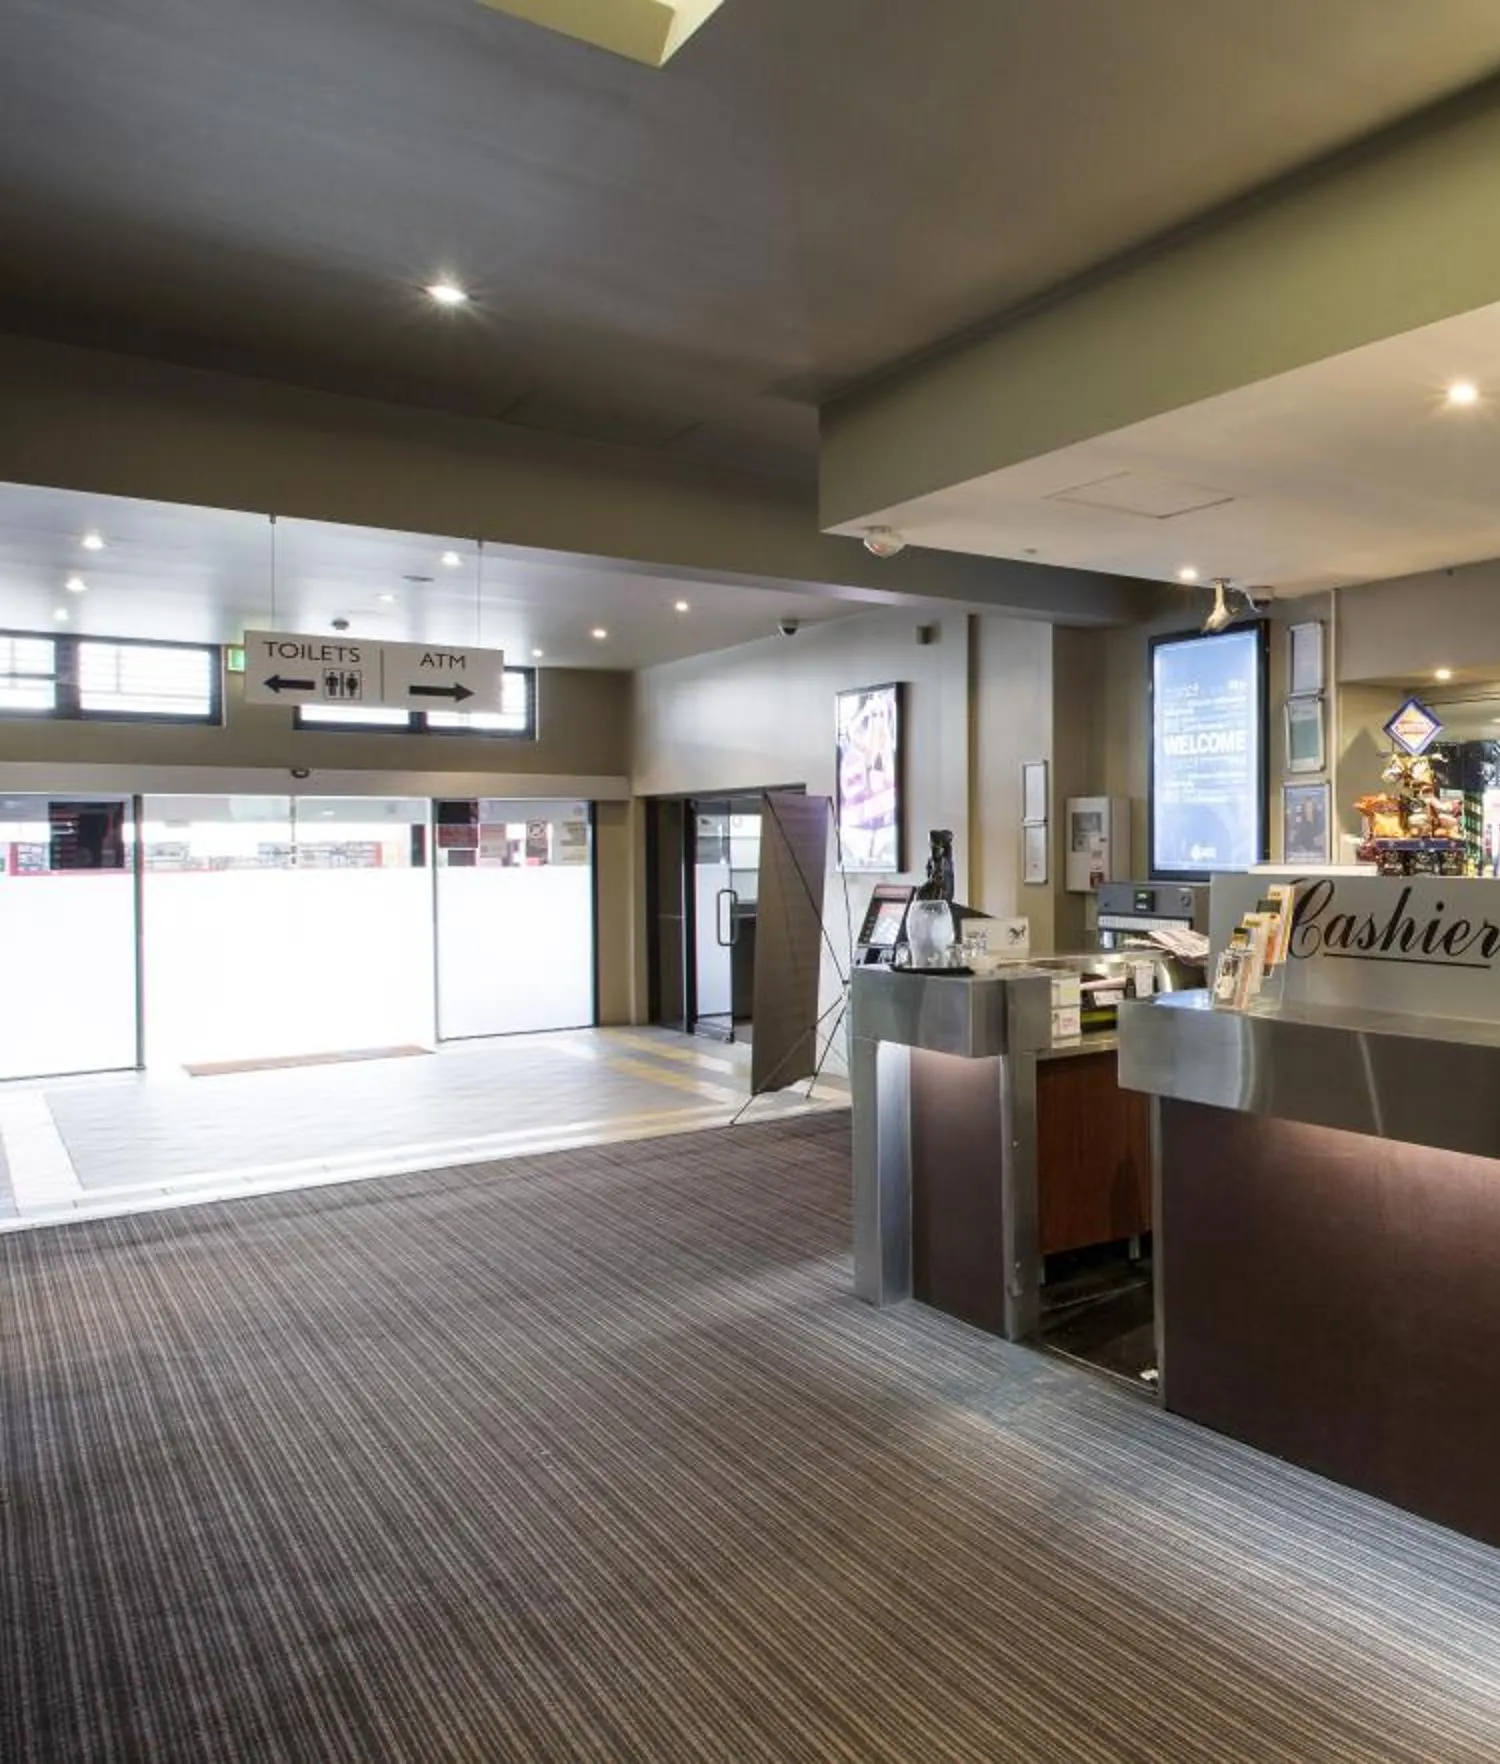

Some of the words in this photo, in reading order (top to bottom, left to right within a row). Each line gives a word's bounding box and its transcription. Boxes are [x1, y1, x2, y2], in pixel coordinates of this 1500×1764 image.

[263, 641, 360, 663] TOILETS
[420, 653, 466, 669] ATM
[1163, 730, 1248, 756] WELCOME
